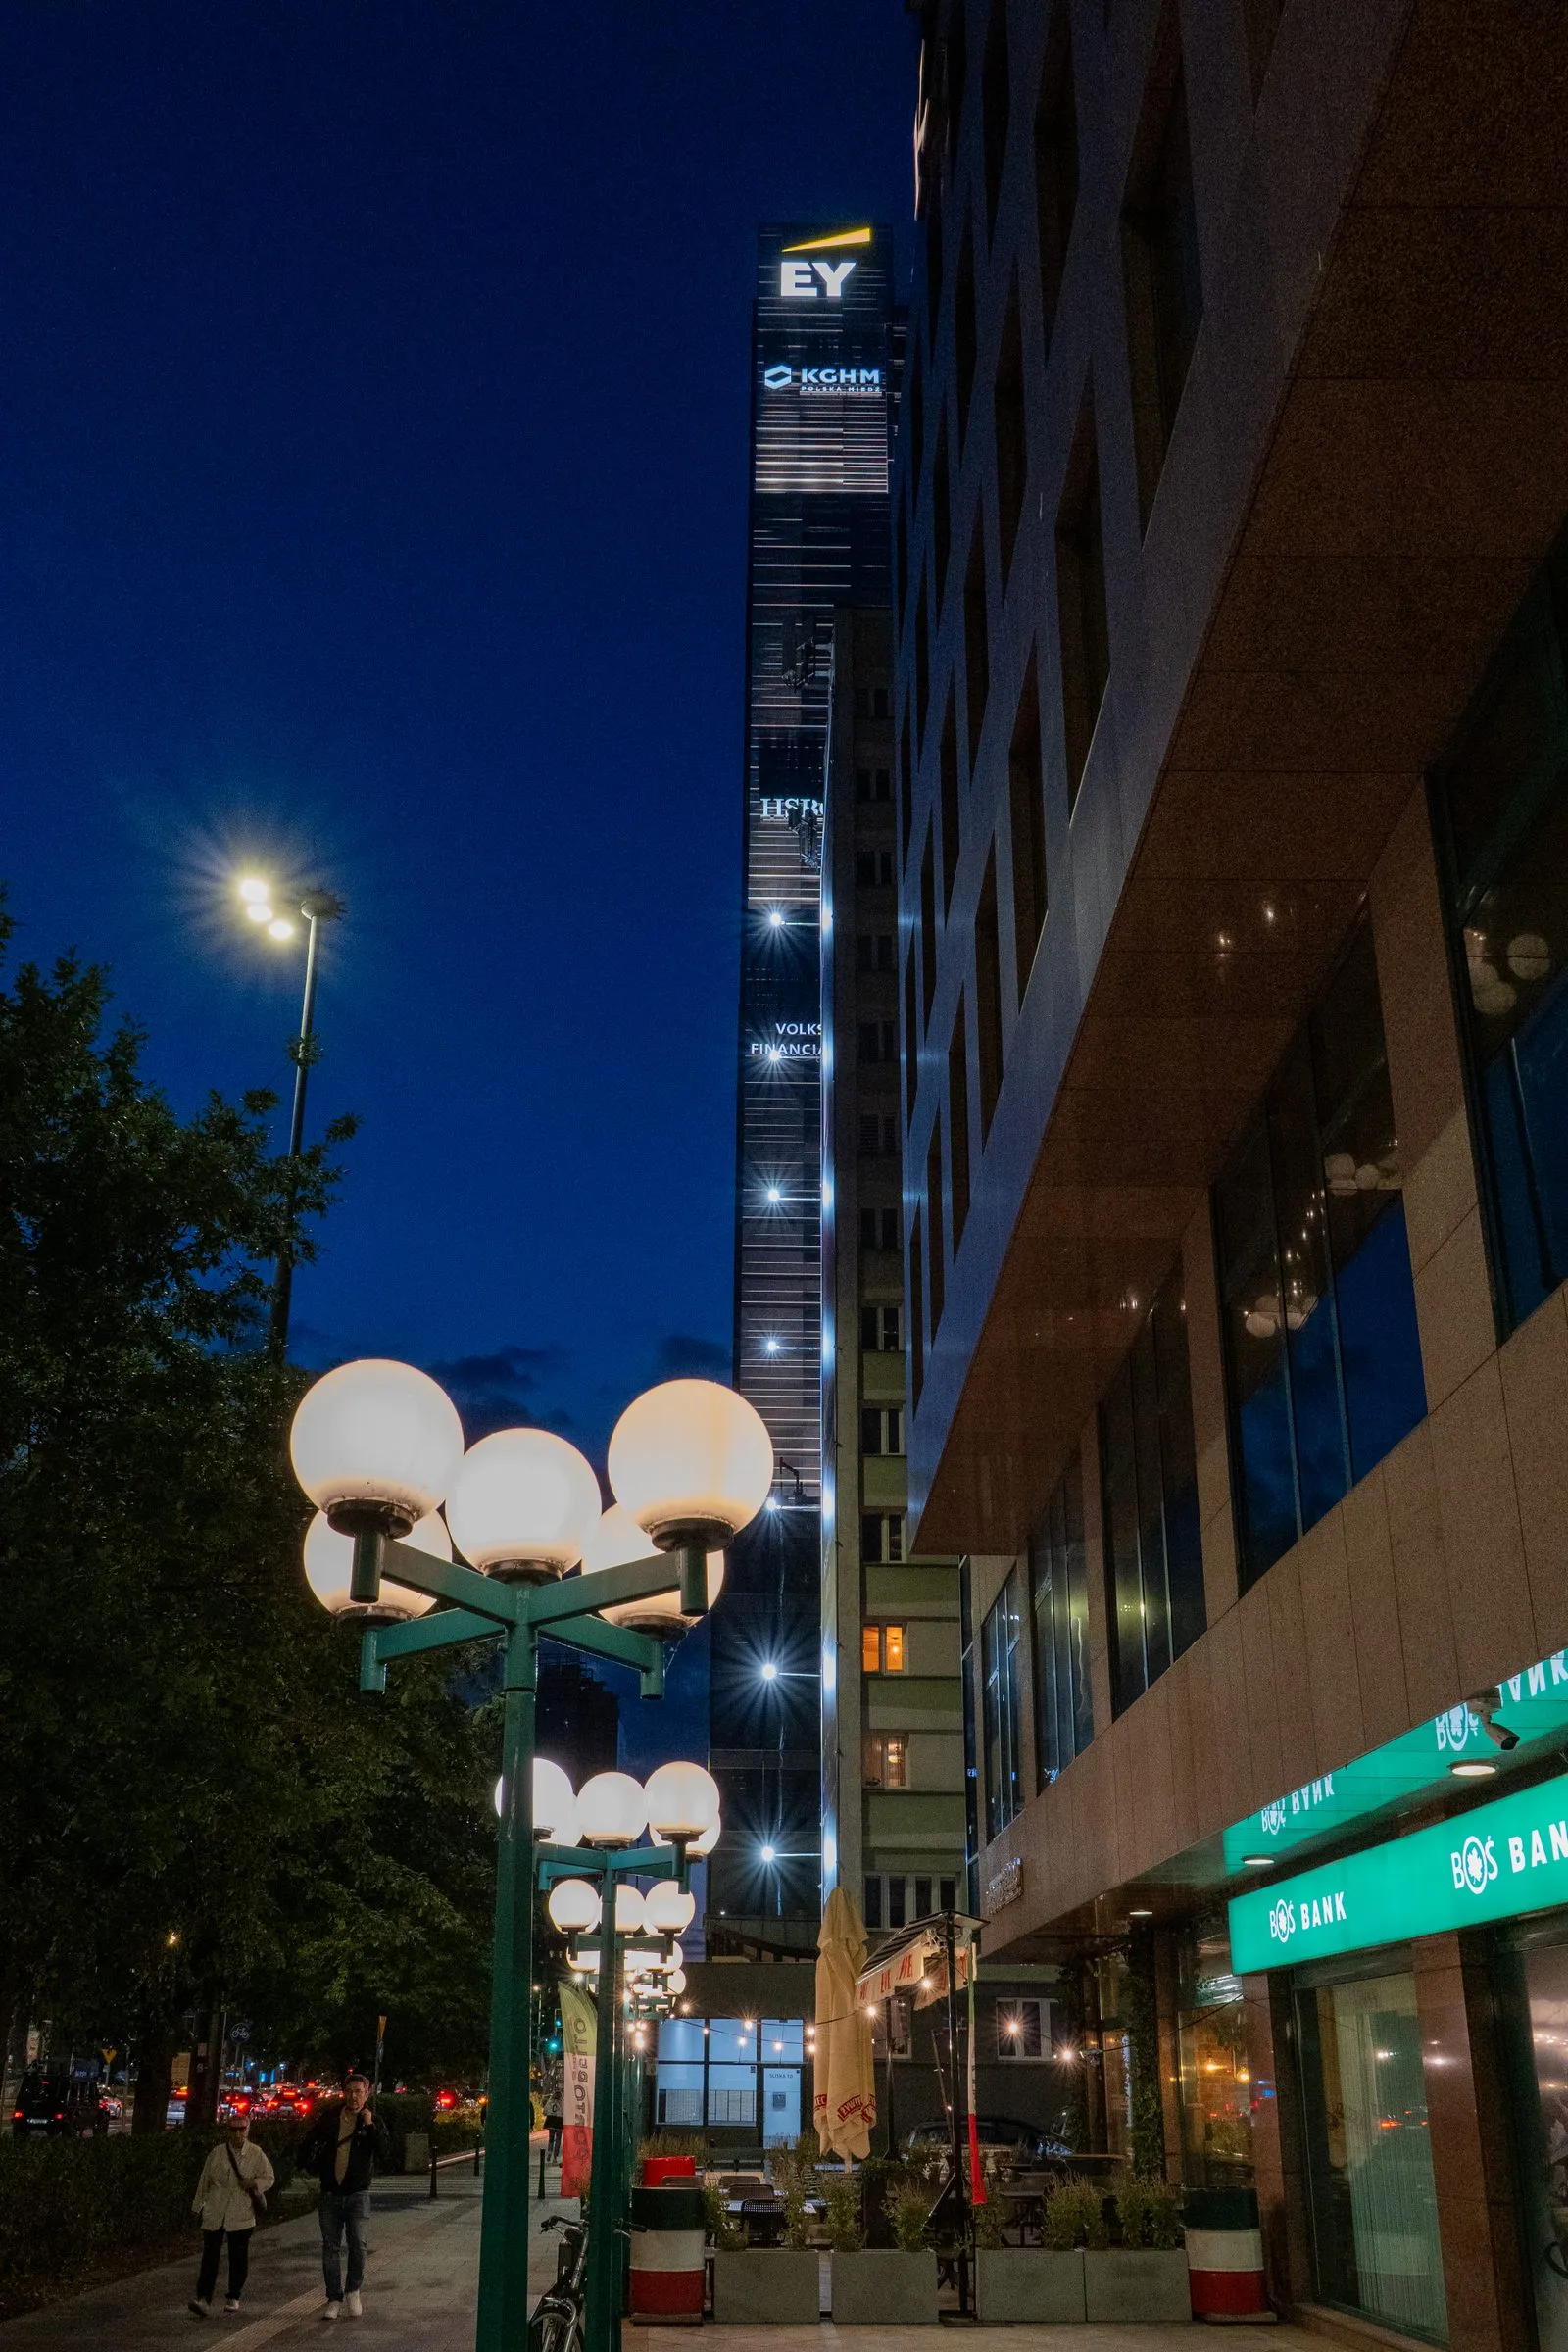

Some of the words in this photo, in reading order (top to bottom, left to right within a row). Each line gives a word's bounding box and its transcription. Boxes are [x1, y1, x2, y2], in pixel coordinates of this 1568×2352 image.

[781, 262, 857, 297] EY
[801, 368, 880, 383] KGHM
[1450, 1835, 1499, 1895] BOŚ
[1269, 1898, 1296, 1943] BOŚ
[1299, 1891, 1348, 1931] BANK
